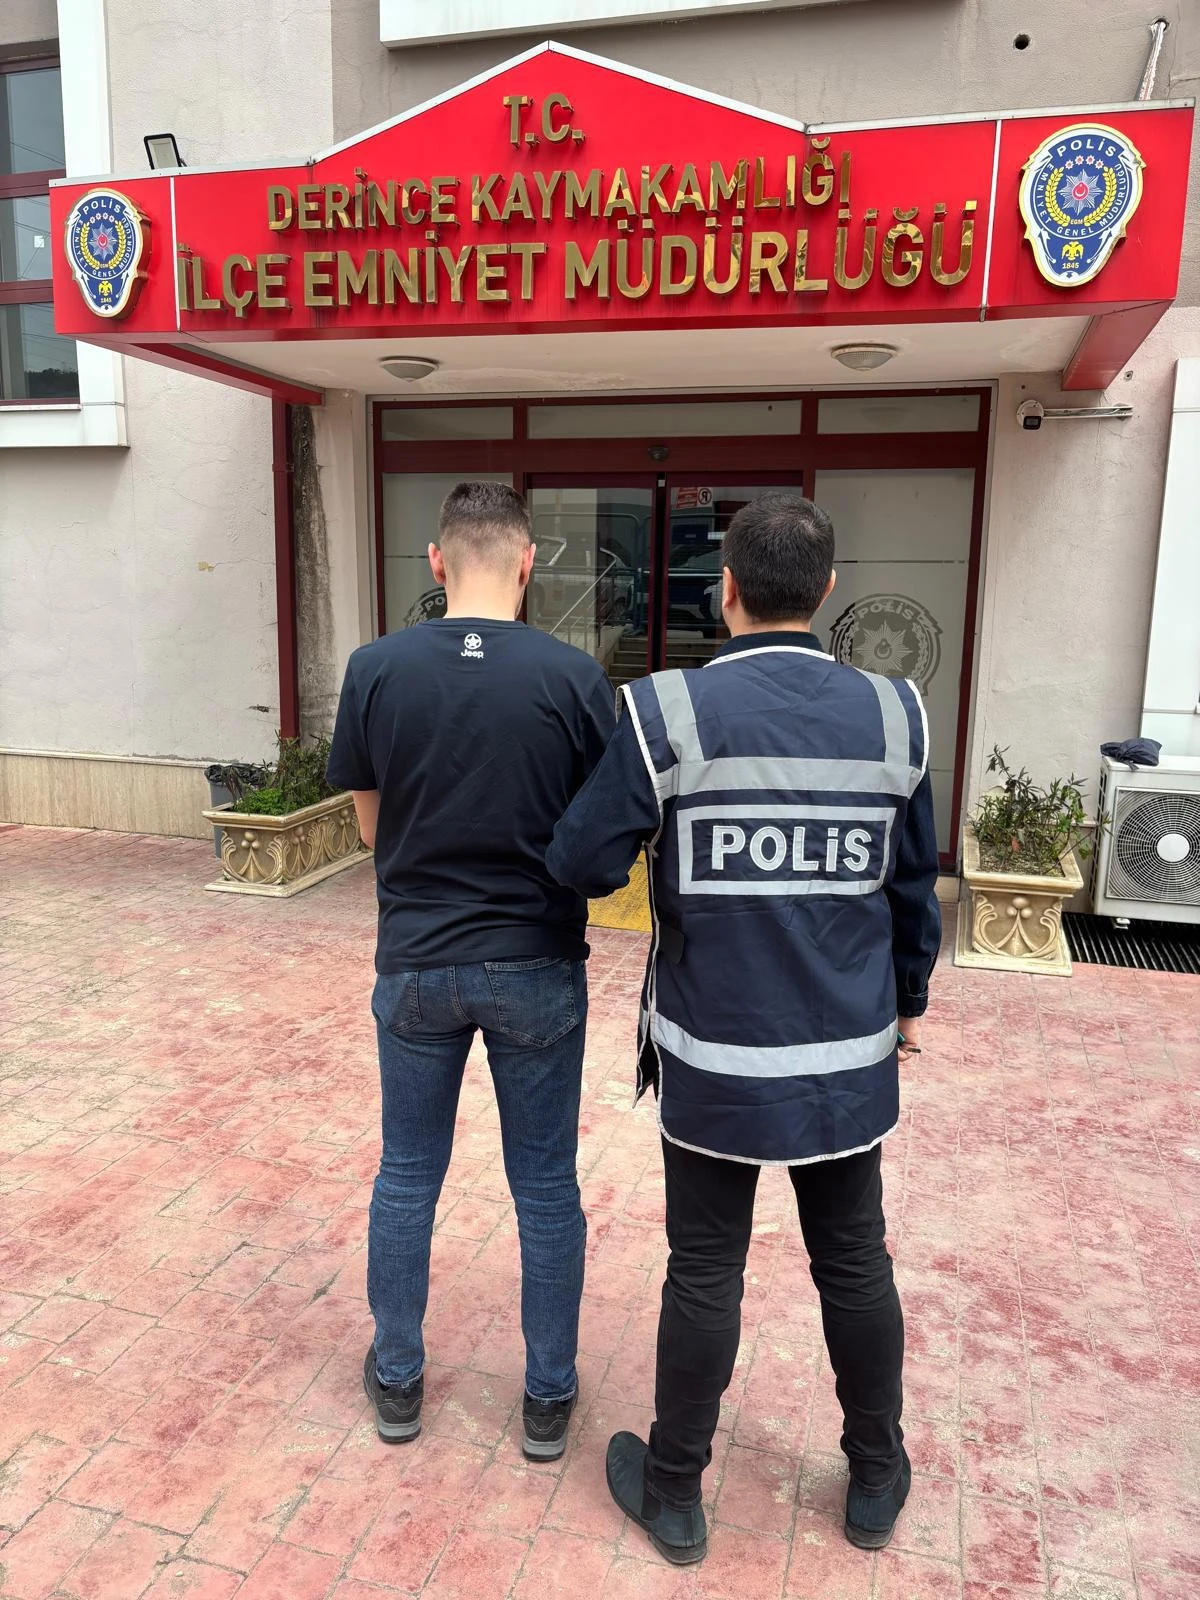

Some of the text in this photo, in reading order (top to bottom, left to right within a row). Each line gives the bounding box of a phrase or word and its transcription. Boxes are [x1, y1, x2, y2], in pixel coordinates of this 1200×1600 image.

[503, 93, 586, 144] T.C.
[1056, 138, 1116, 157] POLİS
[267, 137, 851, 231] DERİNCE KAYMAKAMLIĞI
[82, 199, 122, 215] POLİS
[1057, 226, 1094, 236] GENEL
[177, 200, 977, 318] İLÇE EMNİYET MÜDÜRLÜĞÜ
[461, 649, 484, 659] Jeep
